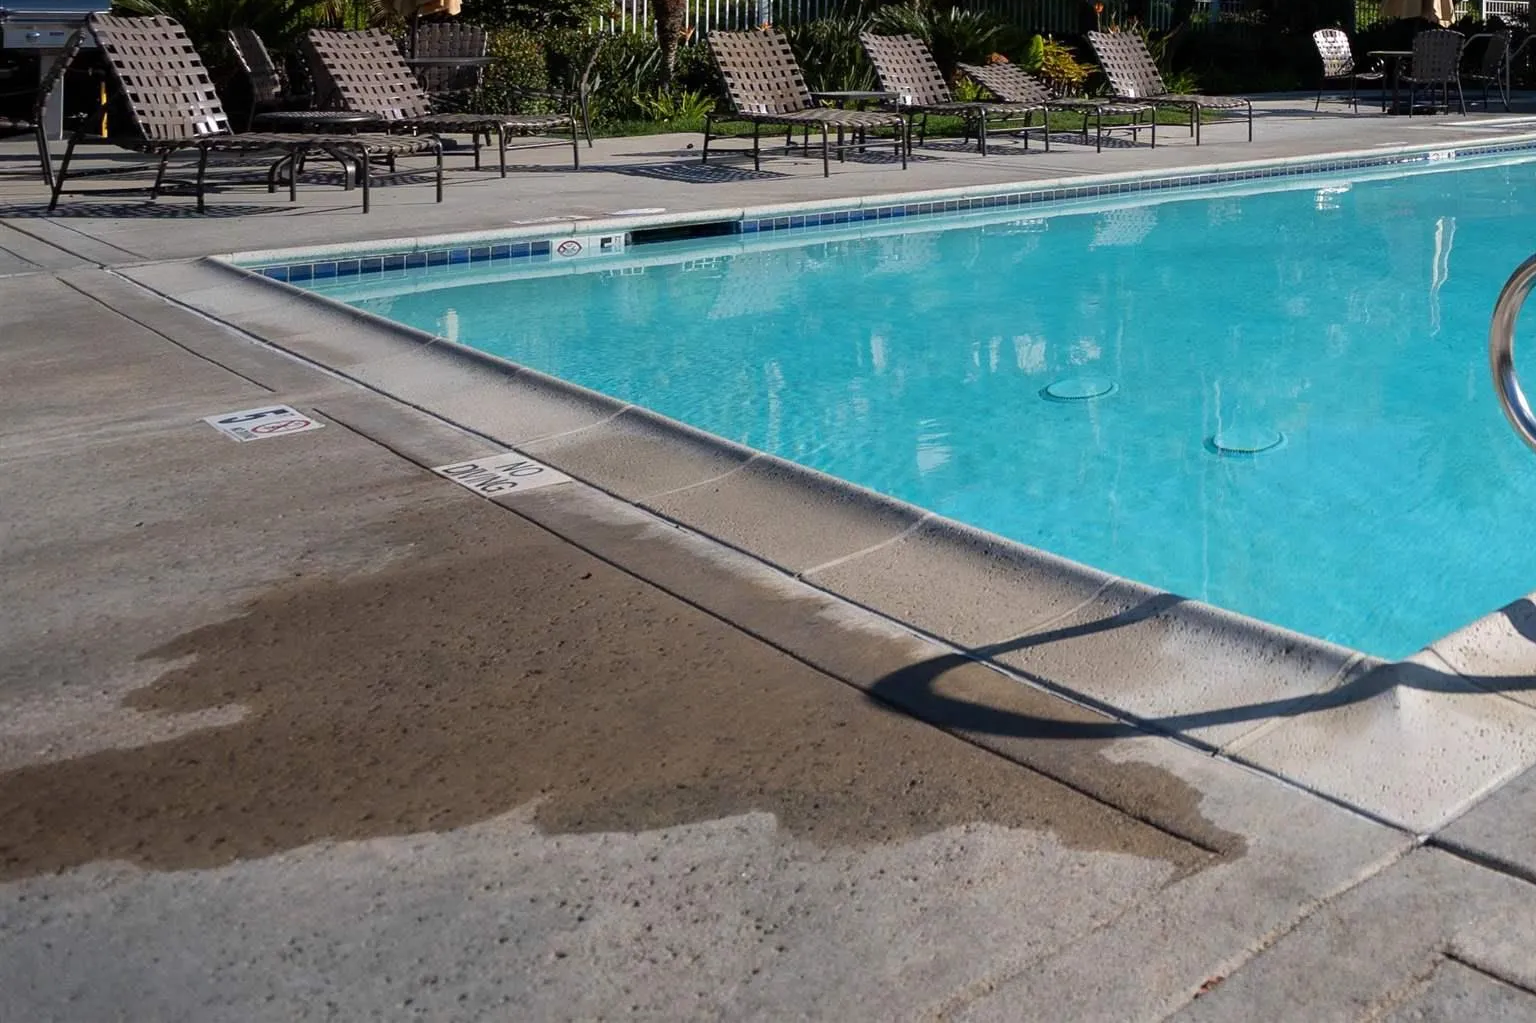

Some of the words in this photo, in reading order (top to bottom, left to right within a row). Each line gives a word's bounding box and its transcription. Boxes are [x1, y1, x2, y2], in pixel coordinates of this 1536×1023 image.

[217, 408, 289, 424] 5
[495, 461, 544, 477] NO
[441, 464, 518, 492] DIVING
